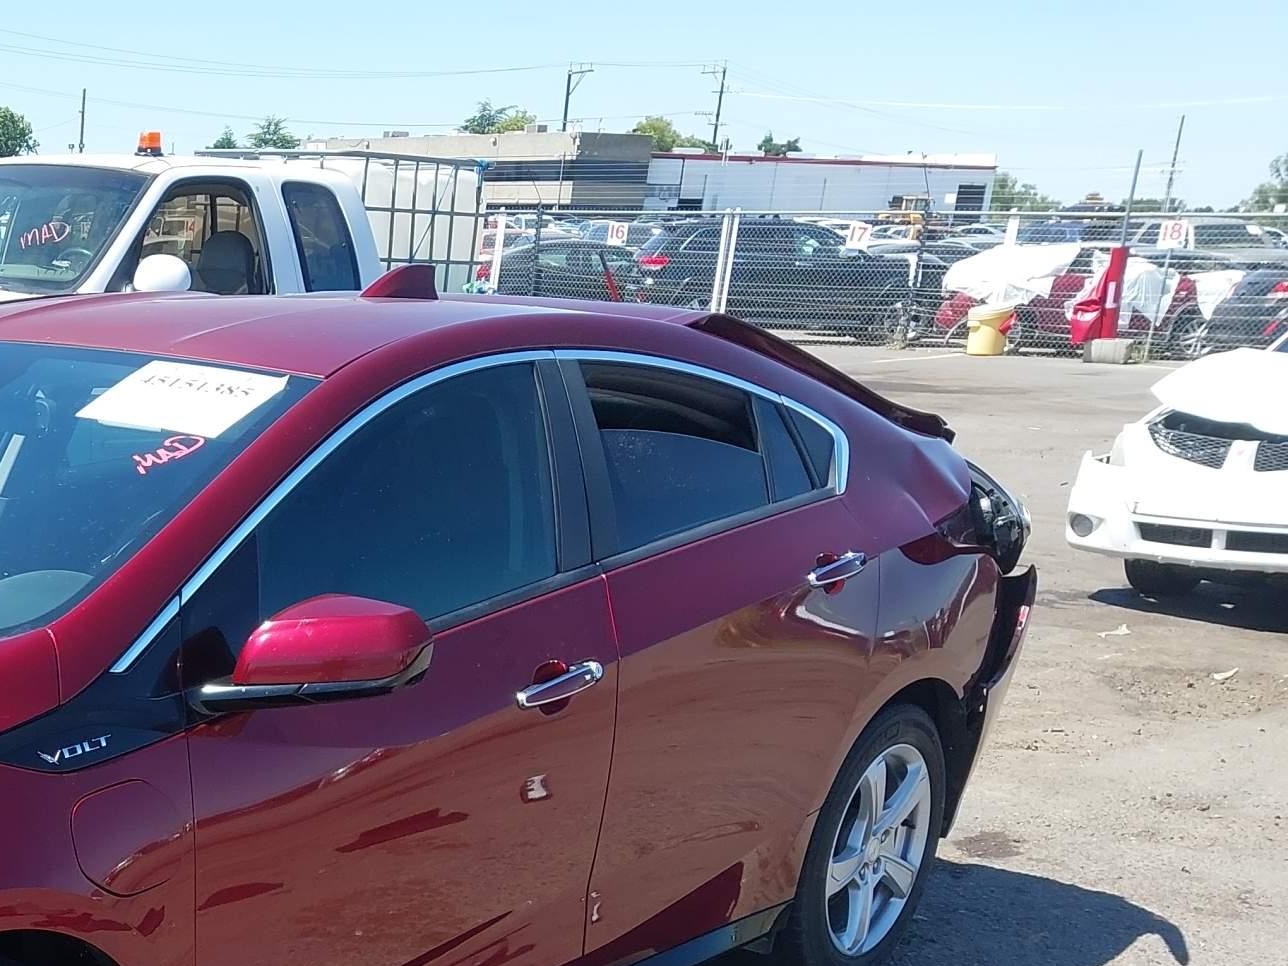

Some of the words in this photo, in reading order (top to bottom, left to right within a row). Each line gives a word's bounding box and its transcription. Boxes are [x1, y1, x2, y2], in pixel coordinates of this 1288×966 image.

[20, 221, 71, 250] MAD
[609, 223, 625, 240] 16
[849, 225, 869, 243] 17
[1162, 222, 1183, 241] 18
[131, 434, 205, 475] MAD
[37, 734, 112, 765] VOLT
